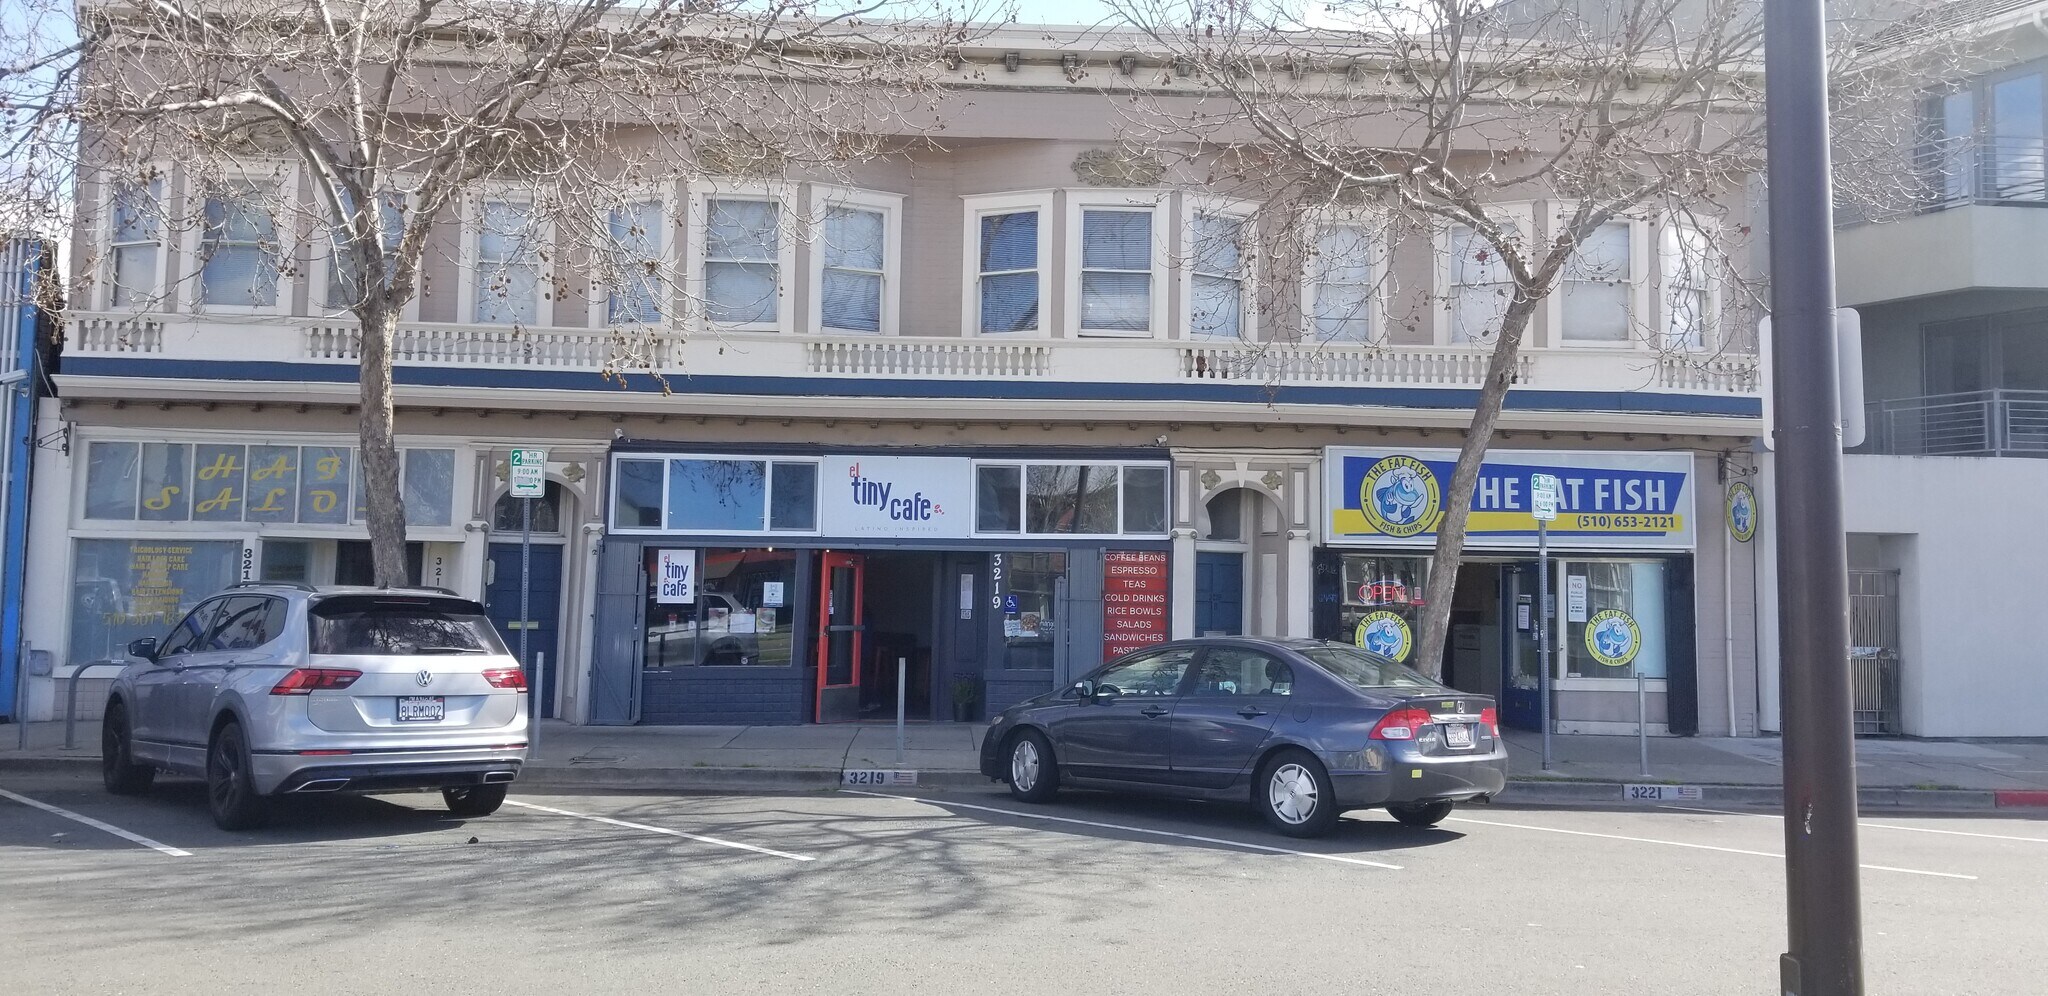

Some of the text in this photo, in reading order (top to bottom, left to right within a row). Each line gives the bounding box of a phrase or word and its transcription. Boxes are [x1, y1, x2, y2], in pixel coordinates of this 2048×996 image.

[513, 452, 521, 465] 2
[849, 462, 861, 478] el
[1366, 457, 1432, 481] THE FAT FISH
[1533, 477, 1539, 489] 2
[144, 486, 341, 513] SALO
[851, 477, 892, 511] tiny
[1474, 476, 1666, 511] HE AT FISH
[890, 492, 931, 521] cafe
[1379, 521, 1395, 533] FISH
[1403, 521, 1423, 534] CHIPS
[1577, 514, 1675, 529] (510) 653-2121
[664, 554, 670, 564] el
[1104, 552, 1166, 562] COFFEE BEANS
[665, 562, 689, 581] tiny
[1111, 566, 1158, 575] ESPRESSO
[663, 579, 687, 597] cafe
[992, 553, 1002, 609] 3219
[1123, 580, 1147, 588] TEAS
[1104, 593, 1165, 603] COLD DRINKS
[1358, 584, 1406, 601] OPEN
[1107, 607, 1162, 616] RICE BOWLS
[1116, 620, 1152, 629] SALADS
[1360, 611, 1407, 629] THE FAT FISH
[1589, 610, 1635, 628] THE FAT FISH
[1103, 633, 1164, 642] SANDWICHES
[1597, 655, 1608, 664] FISH
[401, 705, 442, 718] 8LRM002
[849, 771, 885, 785] 3219
[1631, 786, 1662, 800] 3221
